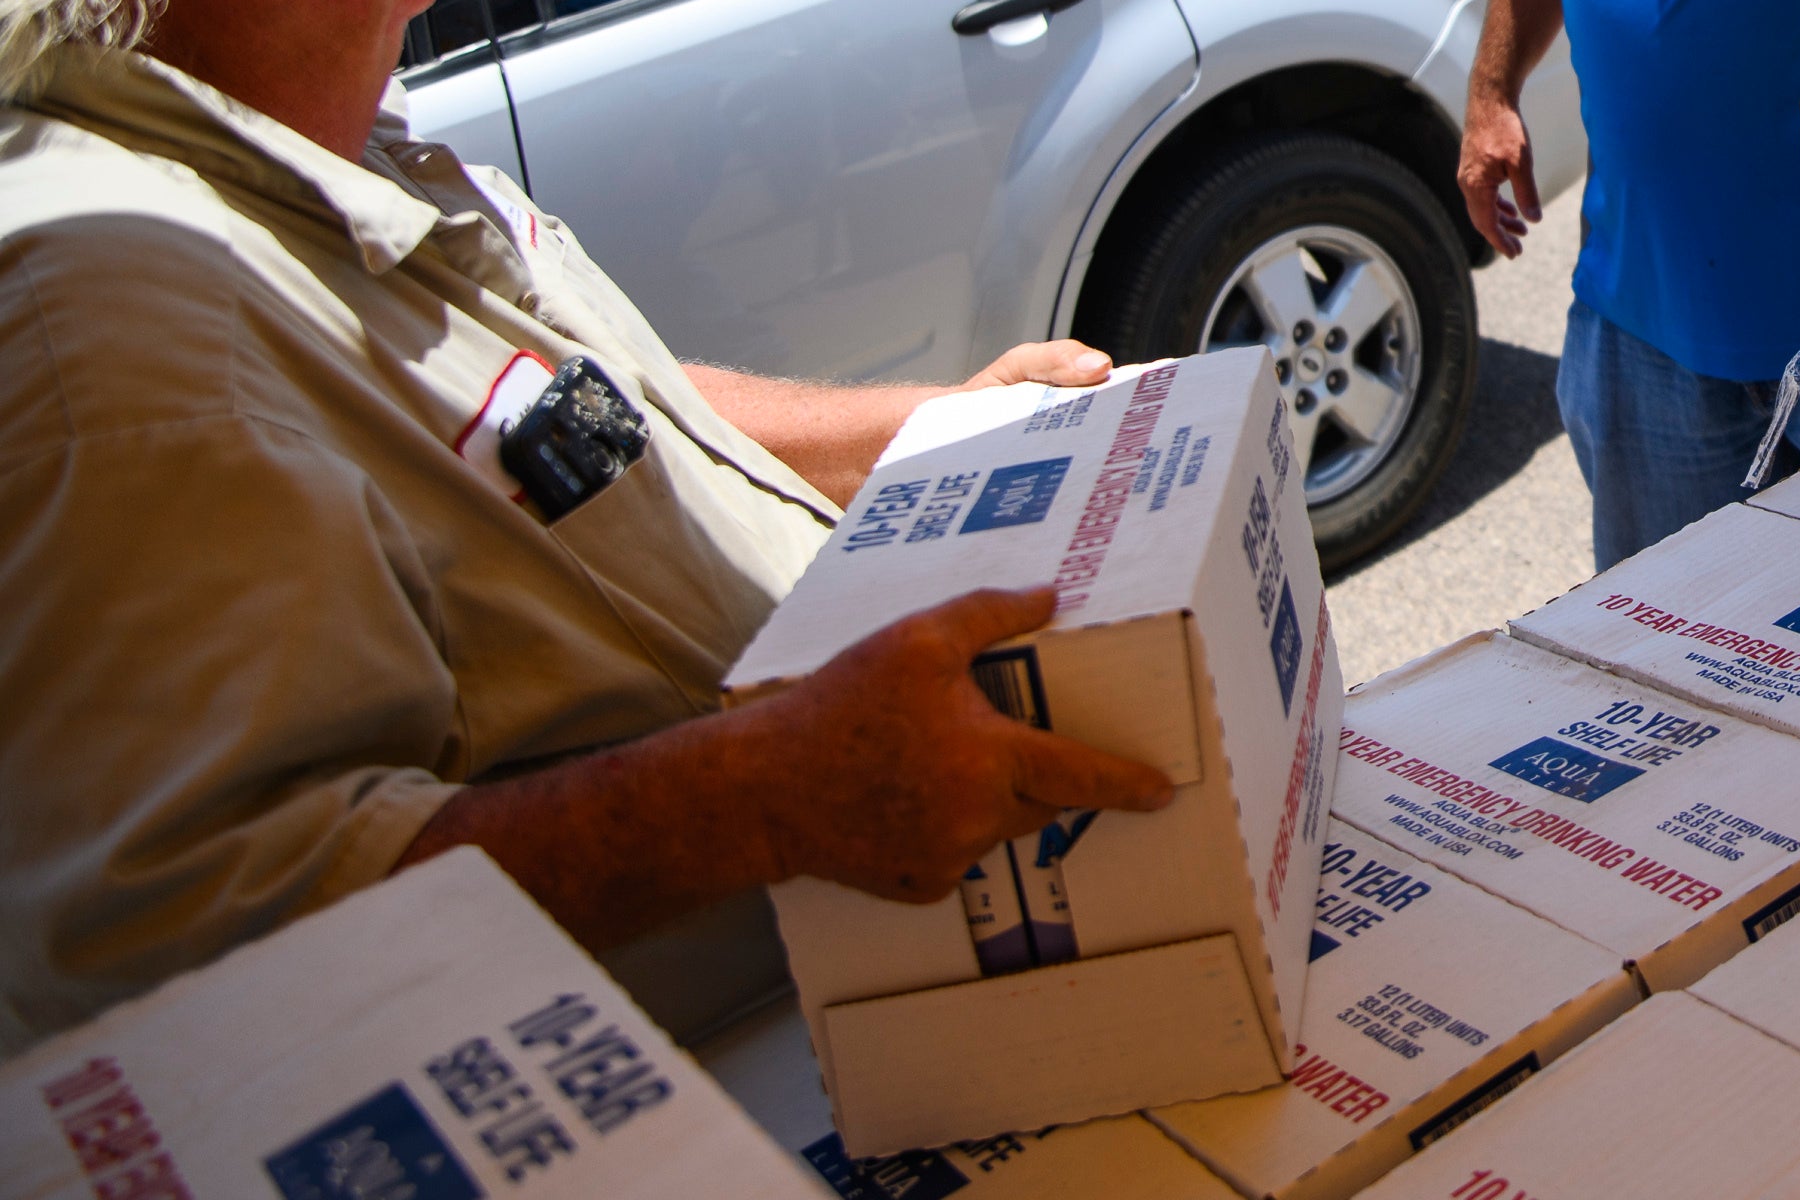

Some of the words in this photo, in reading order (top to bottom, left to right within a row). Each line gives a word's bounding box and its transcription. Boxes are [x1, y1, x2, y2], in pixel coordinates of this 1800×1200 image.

[1128, 364, 1180, 407] WATER
[1104, 404, 1164, 466] DRINKING
[930, 471, 980, 502] LIFE
[992, 474, 1040, 518] AQUA
[842, 479, 930, 553] 10-YEAR
[904, 503, 961, 544] SHELF
[1067, 464, 1138, 552] EMERGENCY
[1052, 553, 1103, 597] YEAR
[1596, 594, 1634, 610] 10
[1623, 602, 1689, 634] YEAR
[1695, 669, 1742, 690] MADE
[1736, 686, 1758, 695] IN
[1753, 689, 1786, 704] USA
[1731, 657, 1774, 676] AQUA
[1557, 721, 1638, 752] SHELF
[1619, 742, 1683, 767] LIFE
[1594, 700, 1721, 749] 10-YEAR
[1523, 751, 1601, 786] AQUA
[1338, 735, 1406, 768] YEAR
[1386, 757, 1529, 820] EMERGENCY
[1508, 808, 1636, 870] DRINKING
[1620, 856, 1723, 912] WATER
[1383, 794, 1524, 860] WWW.AQUABLOX.COM
[1431, 800, 1474, 822] AQUA
[1672, 811, 1708, 828] 33.8
[1698, 822, 1720, 837] FL.
[1718, 830, 1753, 846] OZ.
[1690, 802, 1712, 815] 12
[1718, 814, 1765, 838] LITER)
[1388, 814, 1434, 838] MADE
[1425, 832, 1448, 846] IN
[1442, 840, 1474, 857] USA
[1656, 820, 1690, 837] 3.17
[1682, 832, 1745, 862] GALLONS
[1319, 900, 1385, 937] LIFE
[1445, 1019, 1491, 1047] UNITS
[1288, 1054, 1390, 1124] WATER
